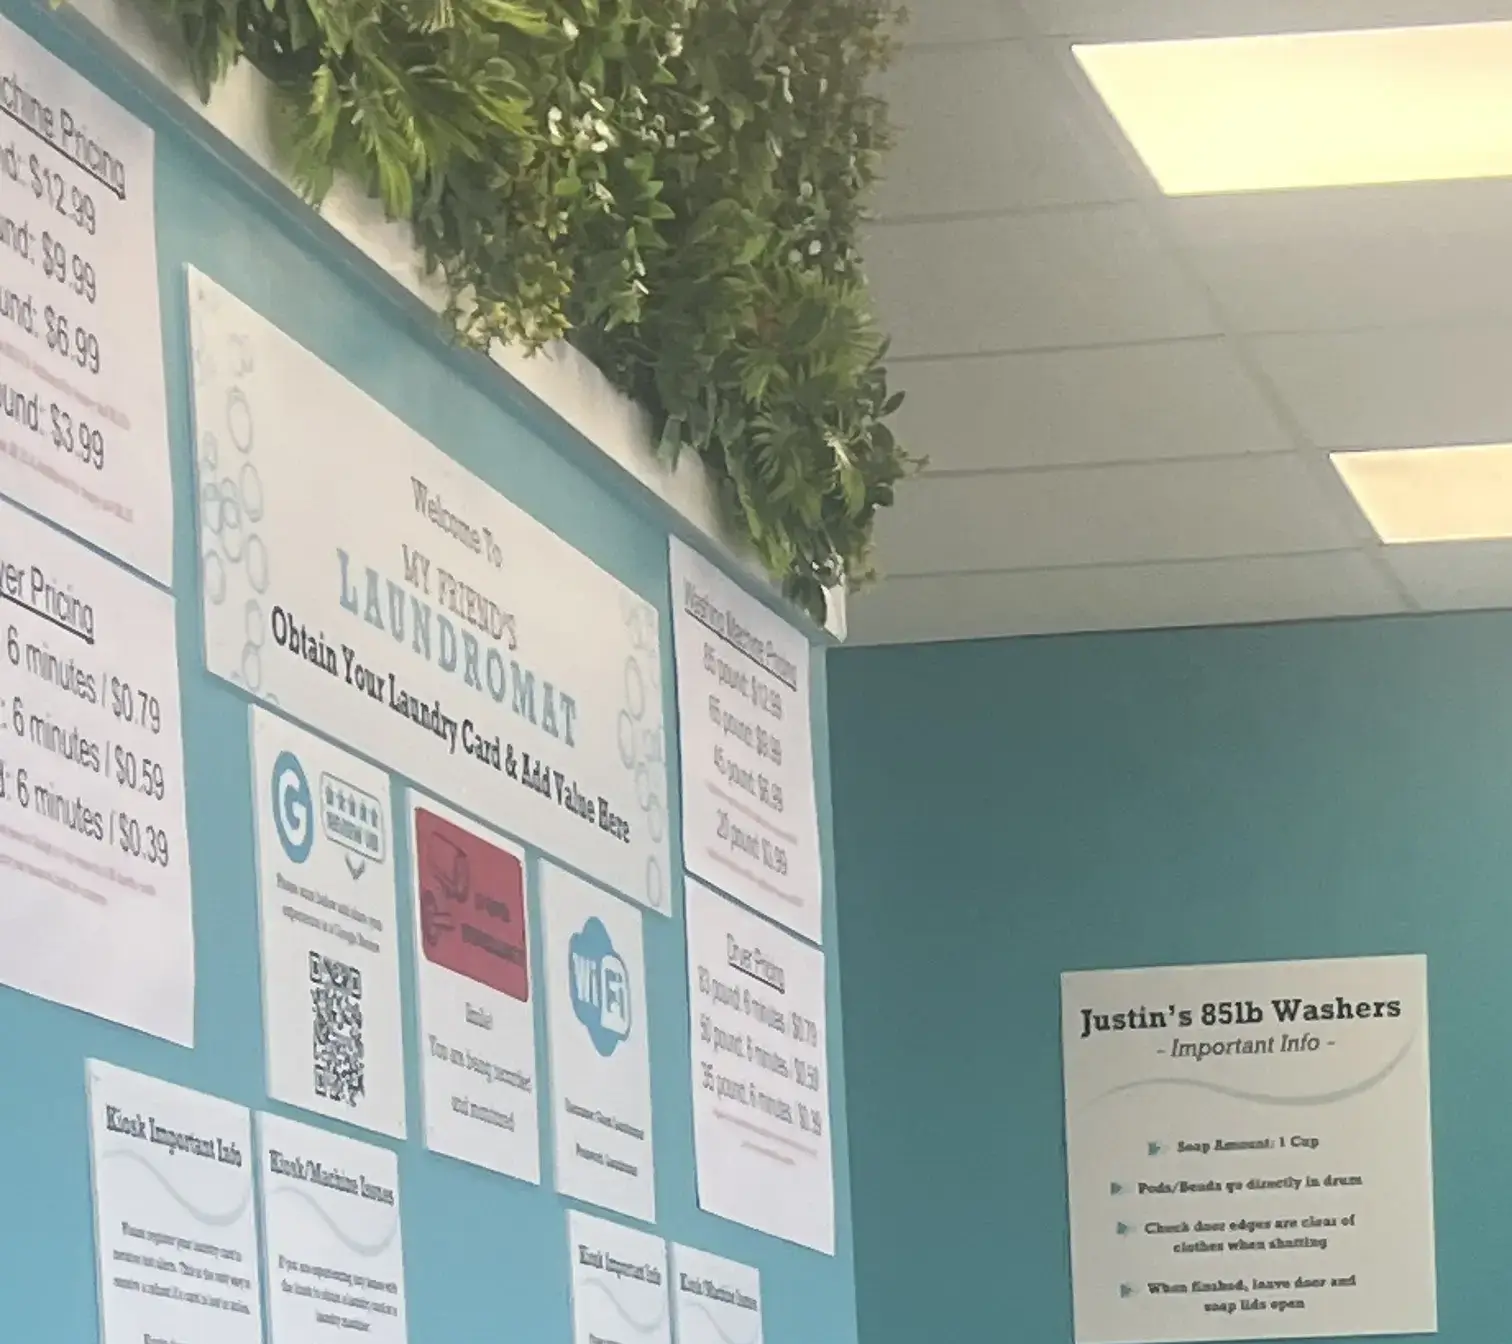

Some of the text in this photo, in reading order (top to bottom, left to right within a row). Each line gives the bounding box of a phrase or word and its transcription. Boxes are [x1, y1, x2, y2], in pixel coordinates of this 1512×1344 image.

[60, 107, 126, 195] Pricing
[29, 153, 96, 236] $12.99
[41, 231, 97, 304] $9.99
[44, 305, 100, 375] $6.99
[50, 403, 105, 471] $3.99
[410, 475, 504, 570] Welcome To
[30, 565, 95, 637] Pricing
[401, 542, 431, 596] MY
[7, 624, 20, 666] 6
[26, 641, 97, 703] minutes
[111, 676, 161, 735] $0.79
[336, 547, 578, 750] LAUNDROMAT
[12, 696, 25, 737] 6
[30, 712, 101, 773] minutes
[115, 744, 165, 801] $0.59
[271, 605, 631, 844] Obtain Your Laundry Card & Add Value Here
[17, 768, 30, 808] 6
[34, 782, 105, 841] minutes
[119, 811, 170, 868] $0.39
[1080, 996, 1402, 1039] Justin's 85lb Washers
[1170, 1036, 1275, 1062] Important
[1279, 1032, 1321, 1053] Info
[1279, 1135, 1286, 1148] 1
[1289, 1134, 1320, 1150] Cup
[1245, 1174, 1303, 1191] directly
[1305, 1174, 1321, 1188] in
[1322, 1172, 1364, 1187] drum
[1172, 1239, 1225, 1254] clothes
[1227, 1237, 1266, 1252] when
[1274, 1217, 1298, 1230] are
[1301, 1214, 1338, 1229] clear
[1340, 1212, 1357, 1227] of
